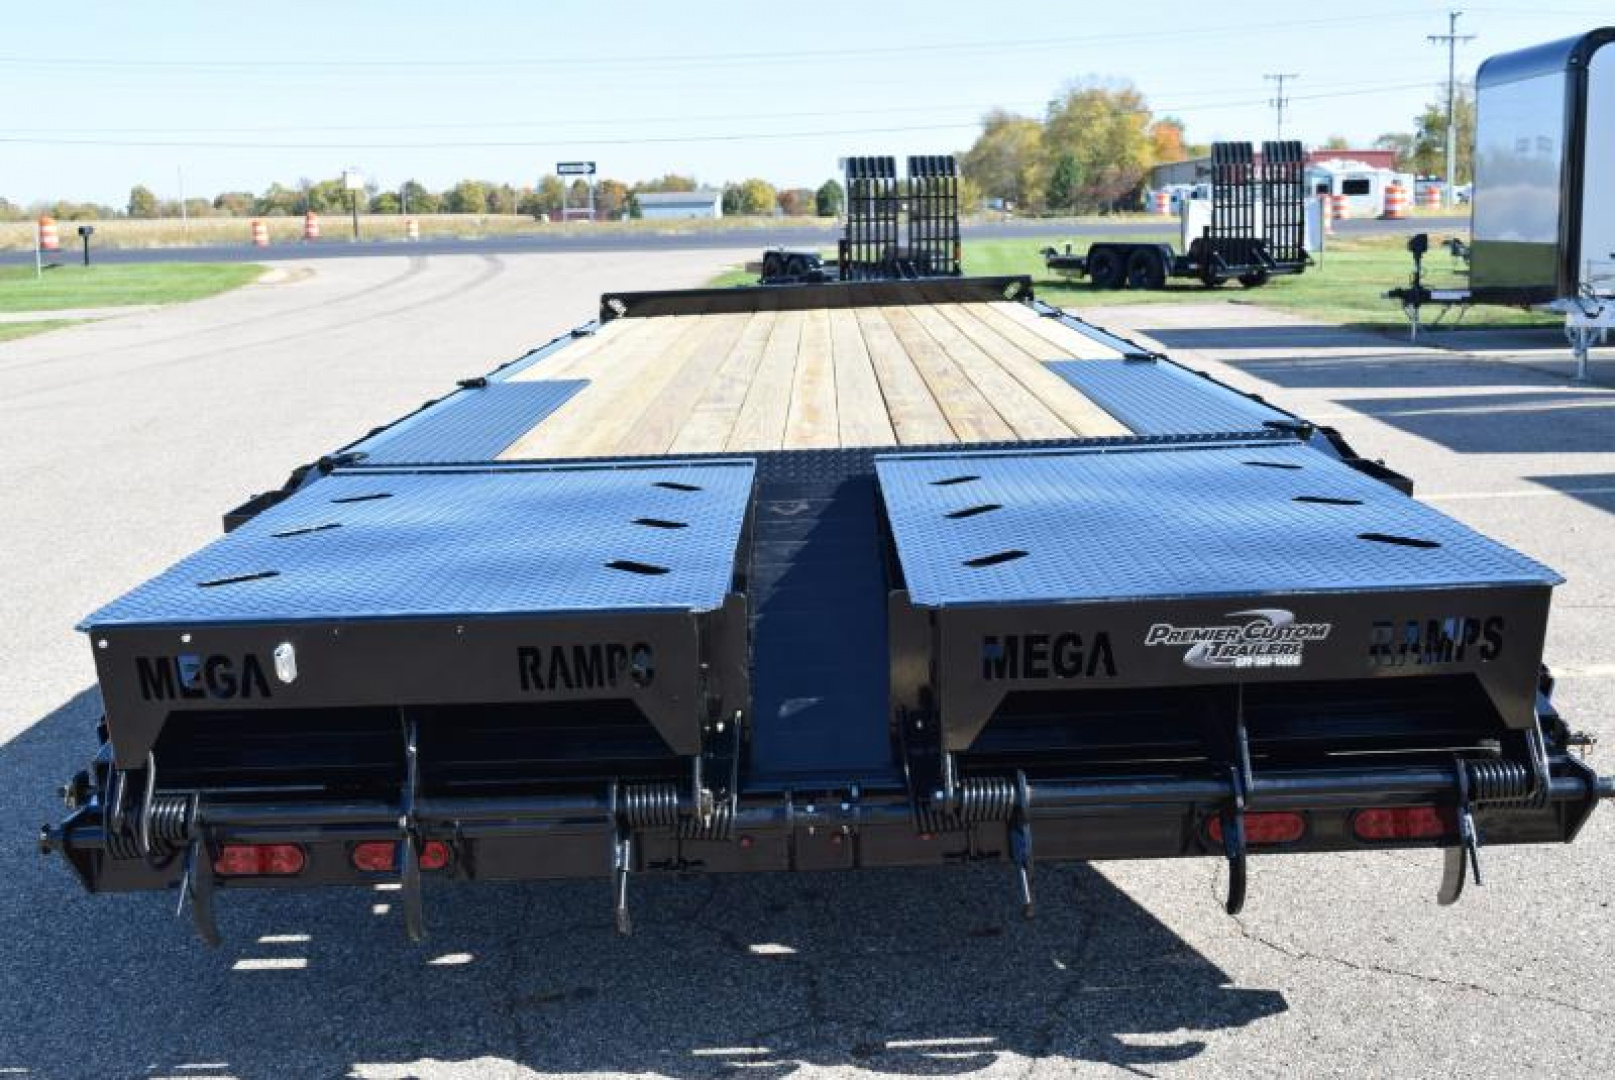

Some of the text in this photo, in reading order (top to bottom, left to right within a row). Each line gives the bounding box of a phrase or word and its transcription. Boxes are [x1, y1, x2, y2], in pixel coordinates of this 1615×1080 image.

[983, 632, 1118, 679] MEGA
[1145, 621, 1331, 645] PREMIER CUSTOM
[1206, 641, 1304, 659] TRAILERS
[1369, 615, 1504, 666] RAMPS
[136, 643, 655, 700] MEGA RAMPS
